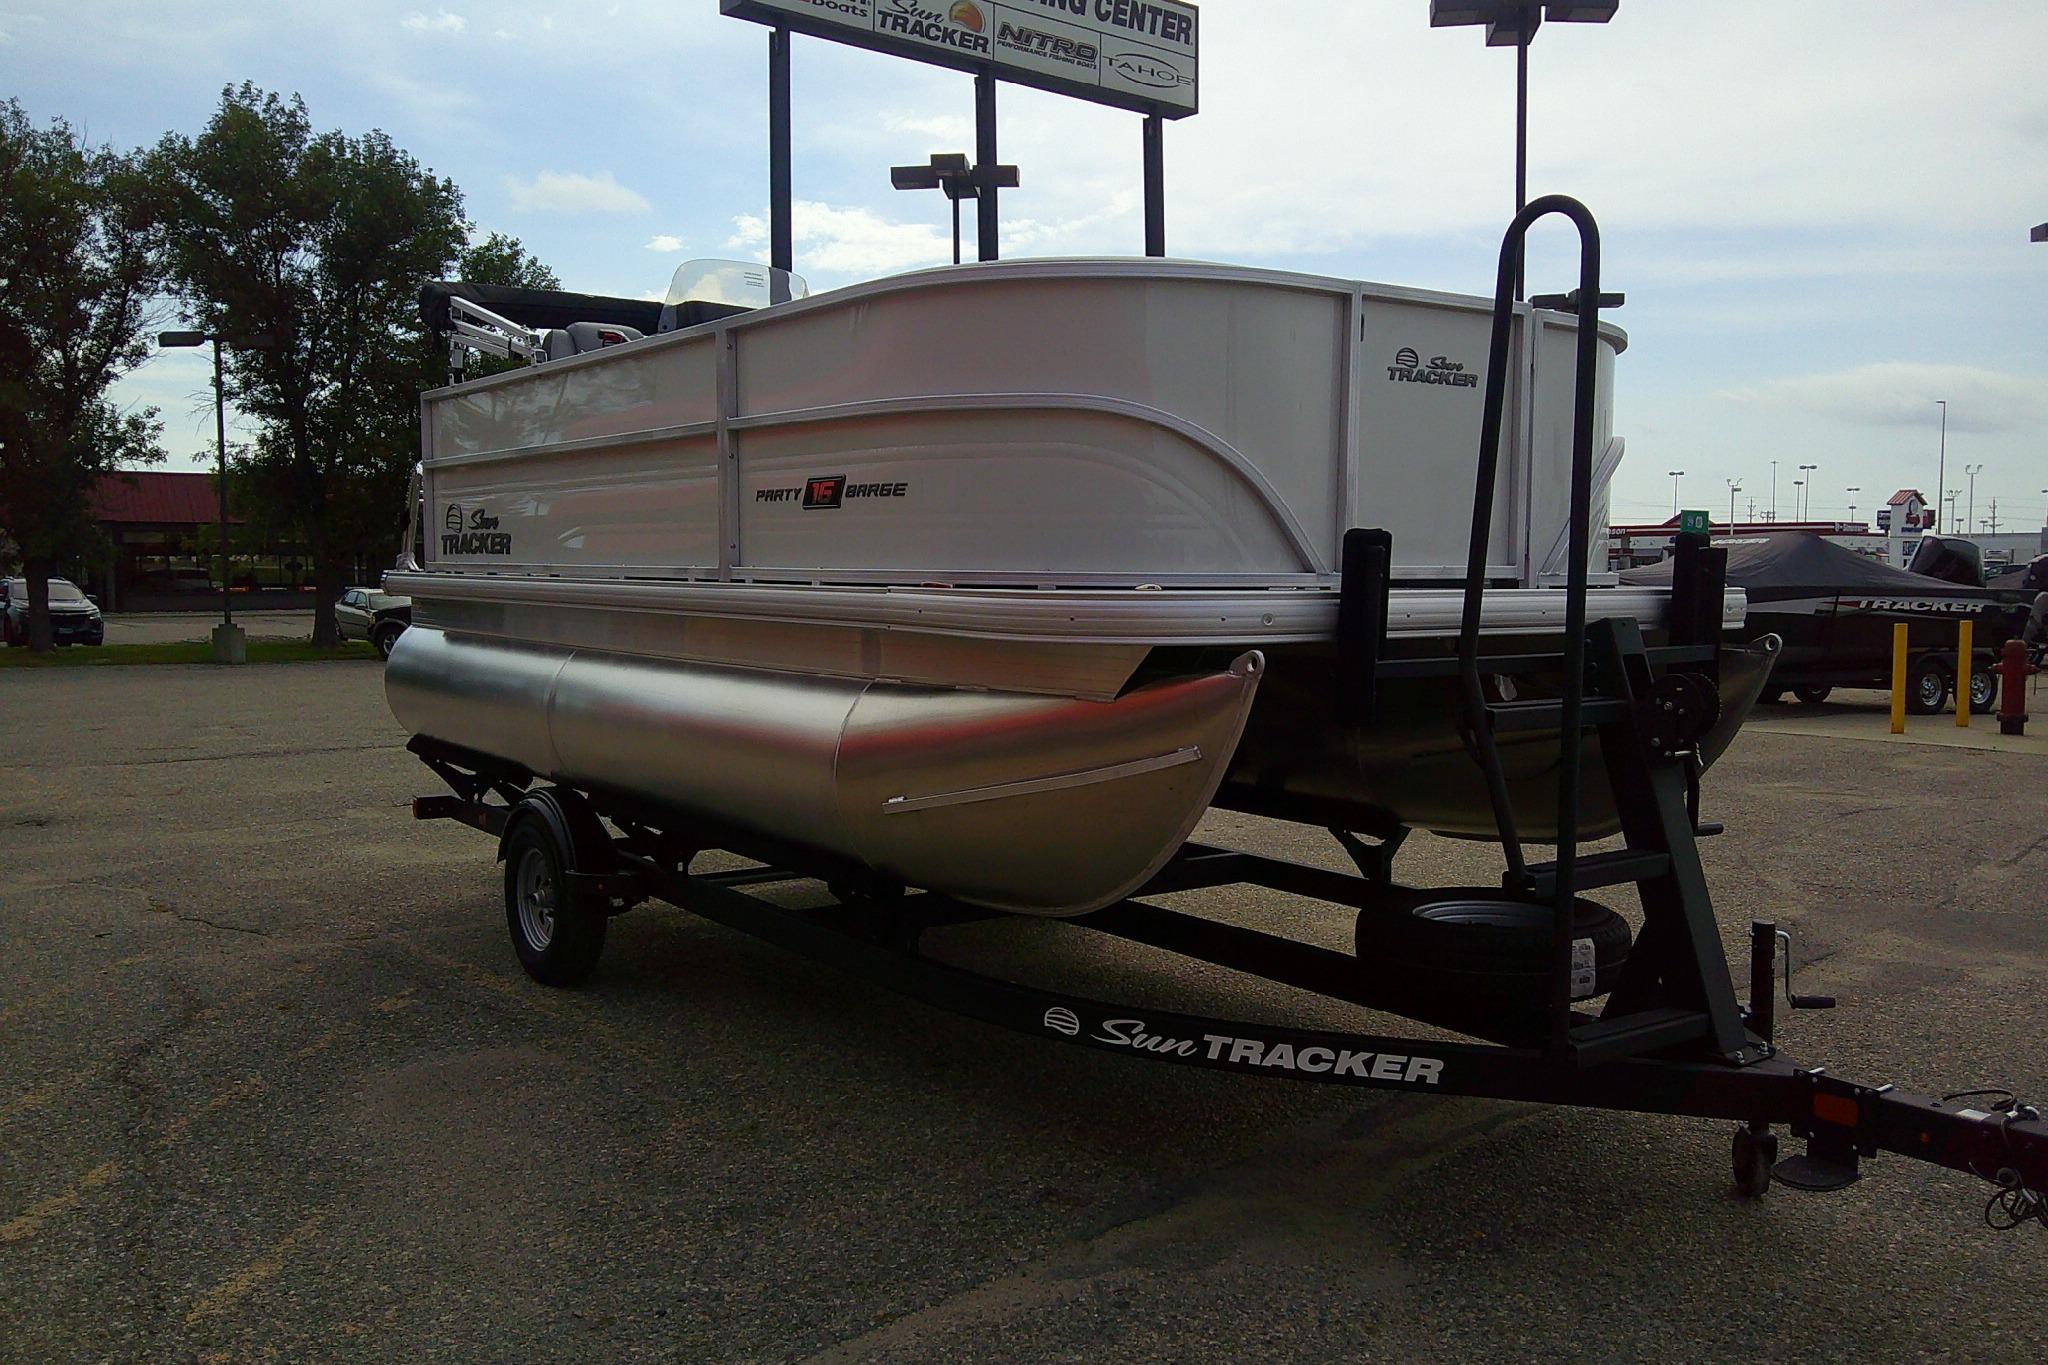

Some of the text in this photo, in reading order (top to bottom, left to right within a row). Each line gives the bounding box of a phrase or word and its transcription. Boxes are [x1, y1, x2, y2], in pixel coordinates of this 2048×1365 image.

[877, 10, 990, 54] TRACKER
[1094, 0, 1192, 45] CENTER
[997, 21, 1098, 62] NITRO
[996, 40, 1097, 70] PERFORMANCE FISHING BOATS
[1102, 55, 1193, 86] TAHOE
[1387, 366, 1479, 388] TRACKER
[1425, 356, 1464, 372] Sun
[755, 487, 803, 502] PARTY
[844, 482, 908, 498] BARGE
[467, 508, 500, 530] Sun
[441, 532, 512, 555] TRACKER
[1858, 599, 1985, 613] TRACKER
[1090, 1018, 1446, 1085] Sun TRACKER
